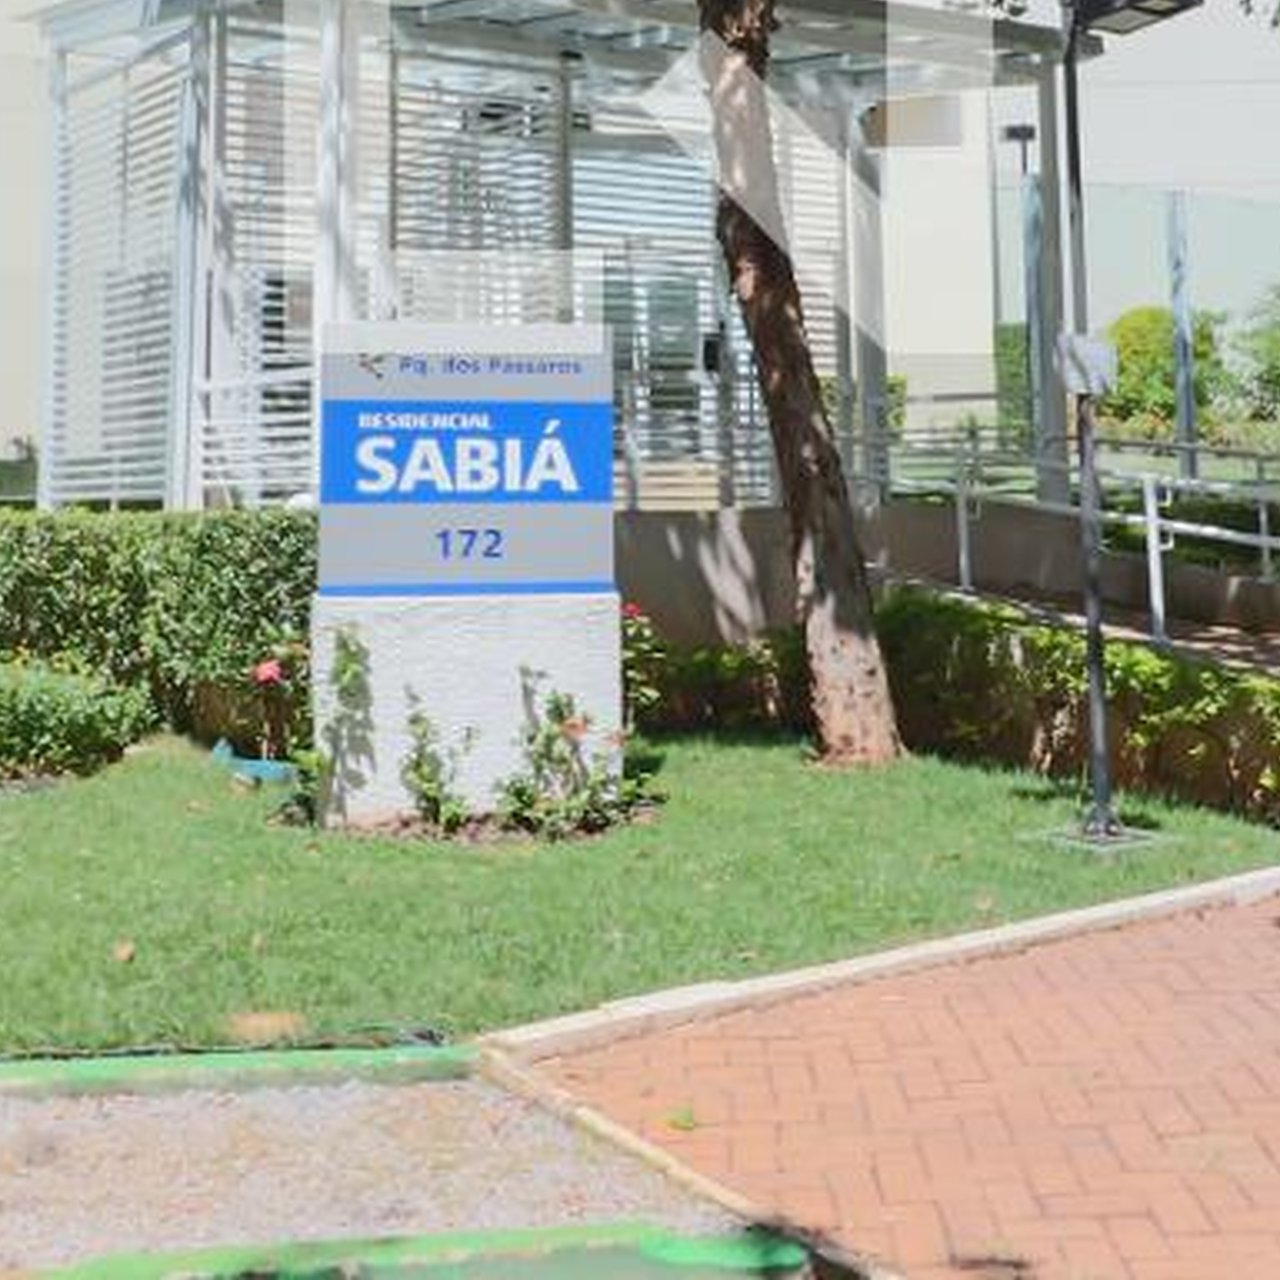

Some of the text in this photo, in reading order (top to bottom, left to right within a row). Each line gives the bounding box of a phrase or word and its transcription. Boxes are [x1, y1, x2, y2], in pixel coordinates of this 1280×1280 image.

[442, 354, 480, 374] dos
[358, 412, 491, 429] RESIDENCIAL
[355, 419, 579, 493] SABIÁ
[435, 529, 503, 559] 172
